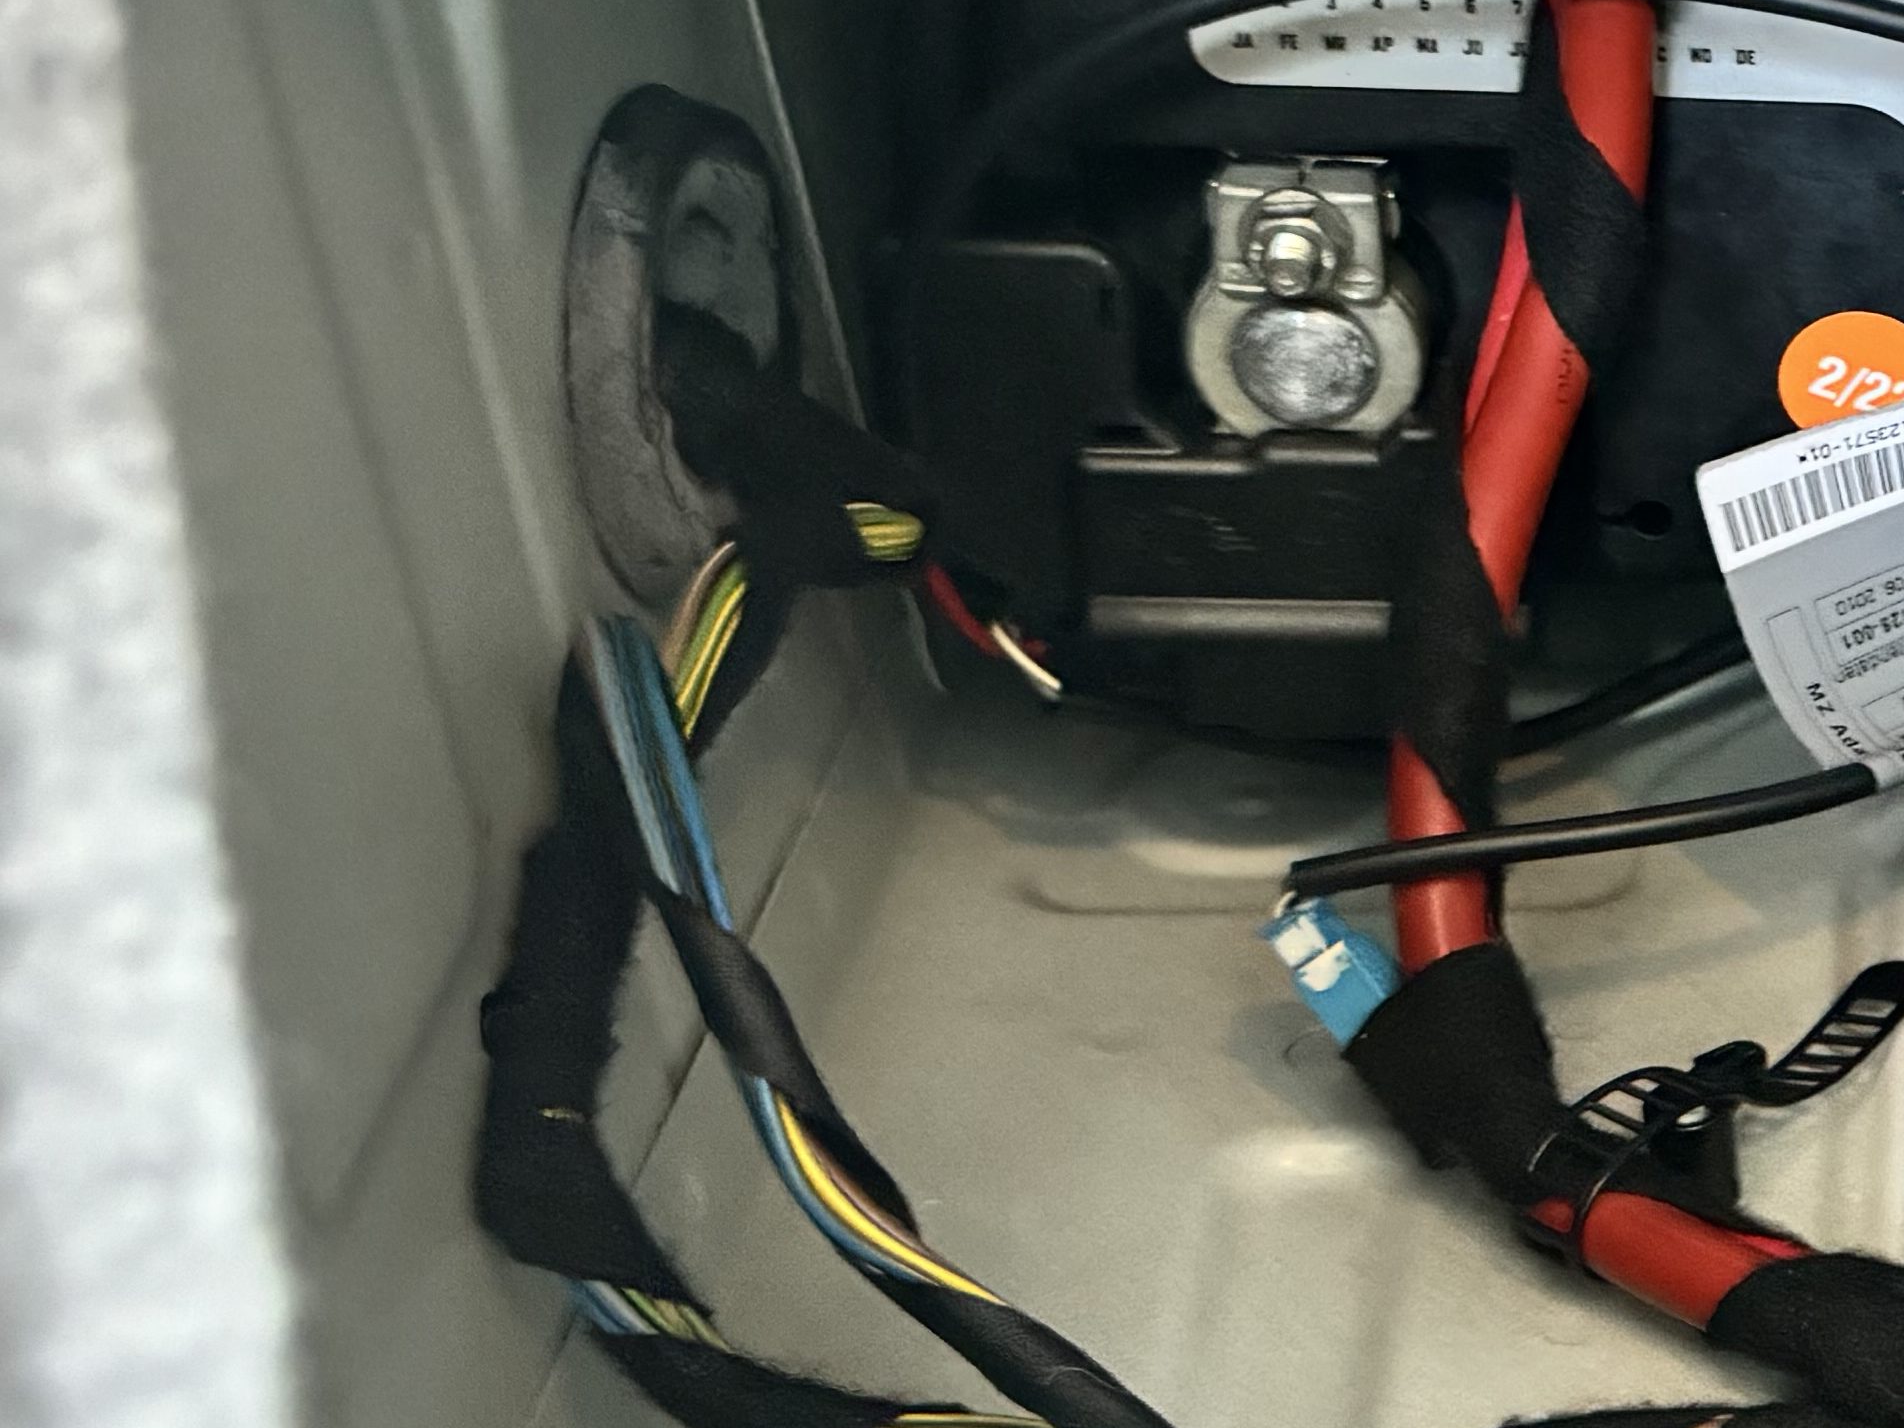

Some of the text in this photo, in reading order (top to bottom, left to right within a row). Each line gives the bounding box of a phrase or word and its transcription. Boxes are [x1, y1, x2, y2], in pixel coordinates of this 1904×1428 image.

[1511, 0, 1523, 14] 7
[1278, 33, 1299, 50] FE
[1372, 36, 1395, 53] AP
[1735, 48, 1757, 65] DE
